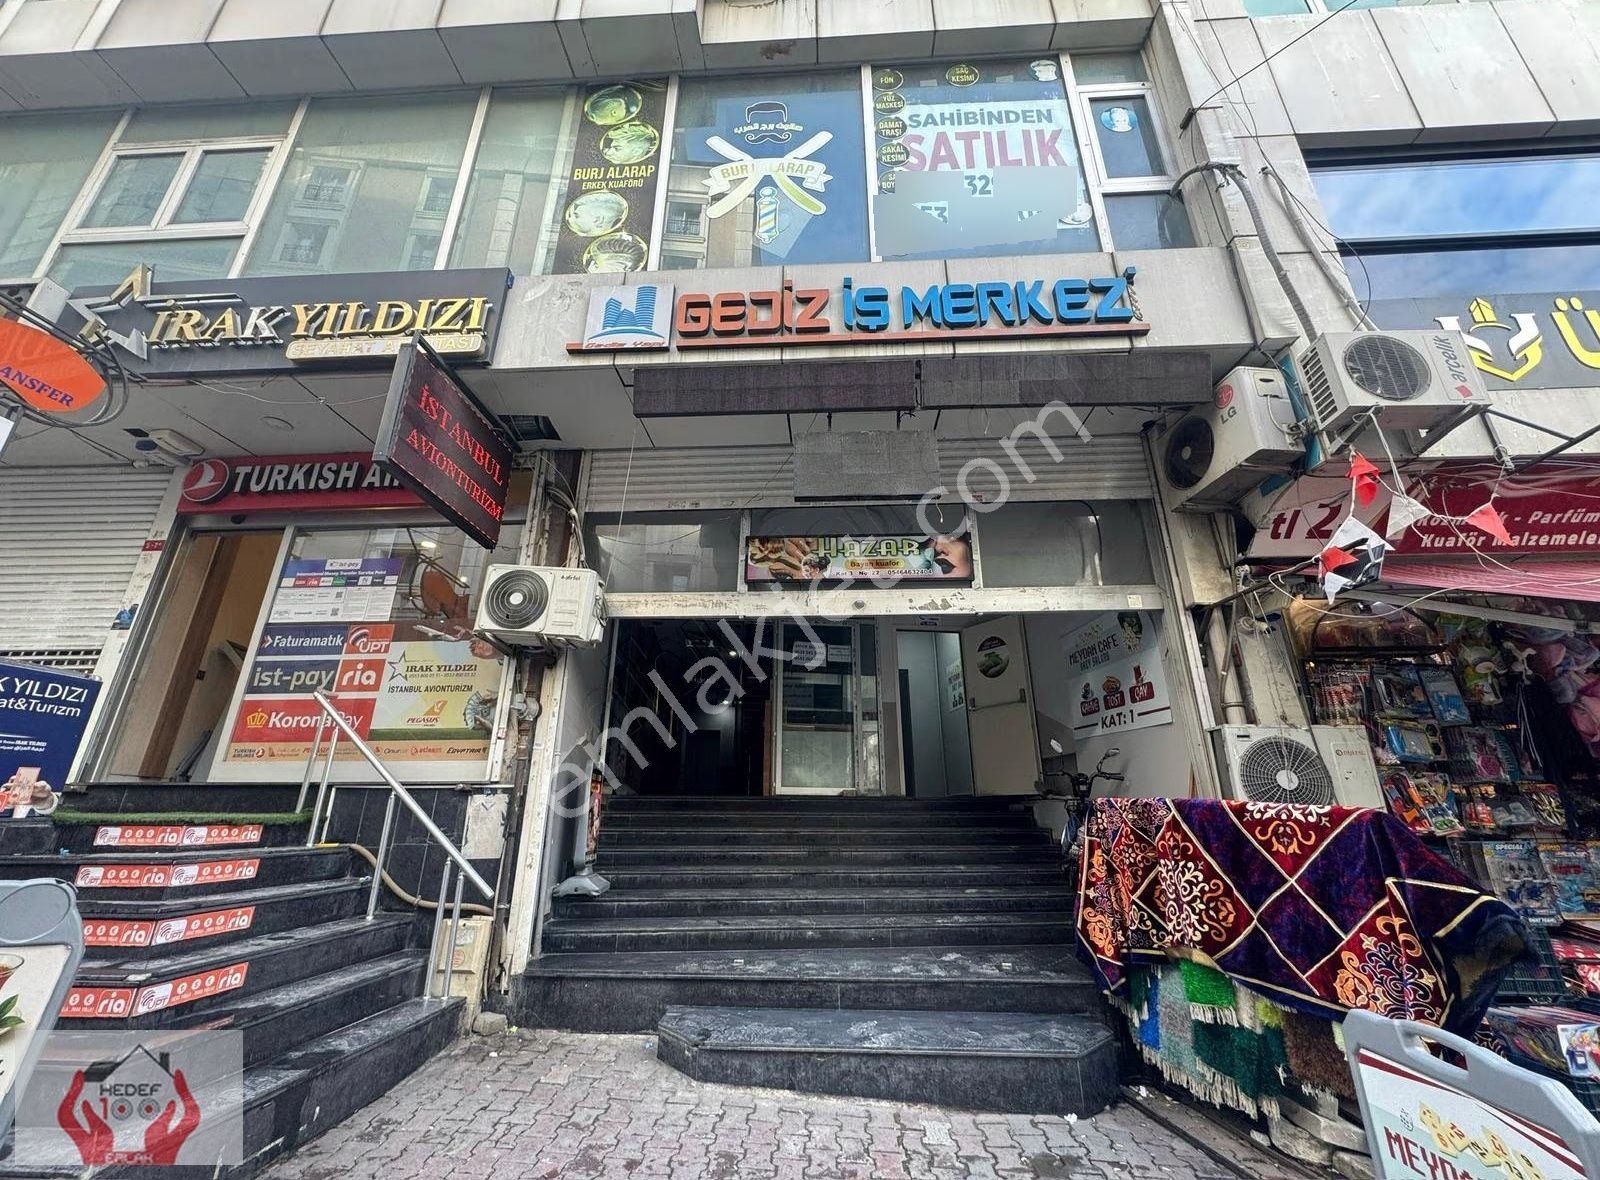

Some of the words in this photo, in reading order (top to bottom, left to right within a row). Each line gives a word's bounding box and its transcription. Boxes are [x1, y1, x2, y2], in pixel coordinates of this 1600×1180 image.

[880, 120, 903, 130] DAMAT
[908, 108, 1052, 128] SAHİBİNDEN
[881, 146, 904, 155] SAKAL
[901, 128, 1068, 171] SATILIK
[573, 167, 604, 180] BURJ
[606, 165, 655, 179] ALARAP
[581, 179, 607, 188] ERKEK
[842, 276, 889, 333] İŞ
[290, 297, 489, 340] YILDIZI
[1433, 334, 1466, 383] arçelik
[1220, 406, 1237, 425] LG
[418, 383, 504, 487] İSTANBUL
[233, 462, 360, 495] TURKISH
[811, 535, 921, 559] HAZAR
[1420, 532, 1487, 548] Kuaför
[1491, 530, 1600, 547] Malzemele
[1097, 633, 1120, 653] CAFE
[253, 667, 335, 691] ist-pay
[341, 662, 377, 686] ria
[14, 678, 88, 703] YILDIZI
[157, 830, 176, 843] ria
[241, 828, 258, 840] ria
[143, 868, 164, 883] ria
[235, 863, 255, 876] ria
[228, 912, 248, 927] ria
[121, 925, 145, 942] ria
[218, 968, 241, 989] ria
[98, 992, 126, 1013] ria
